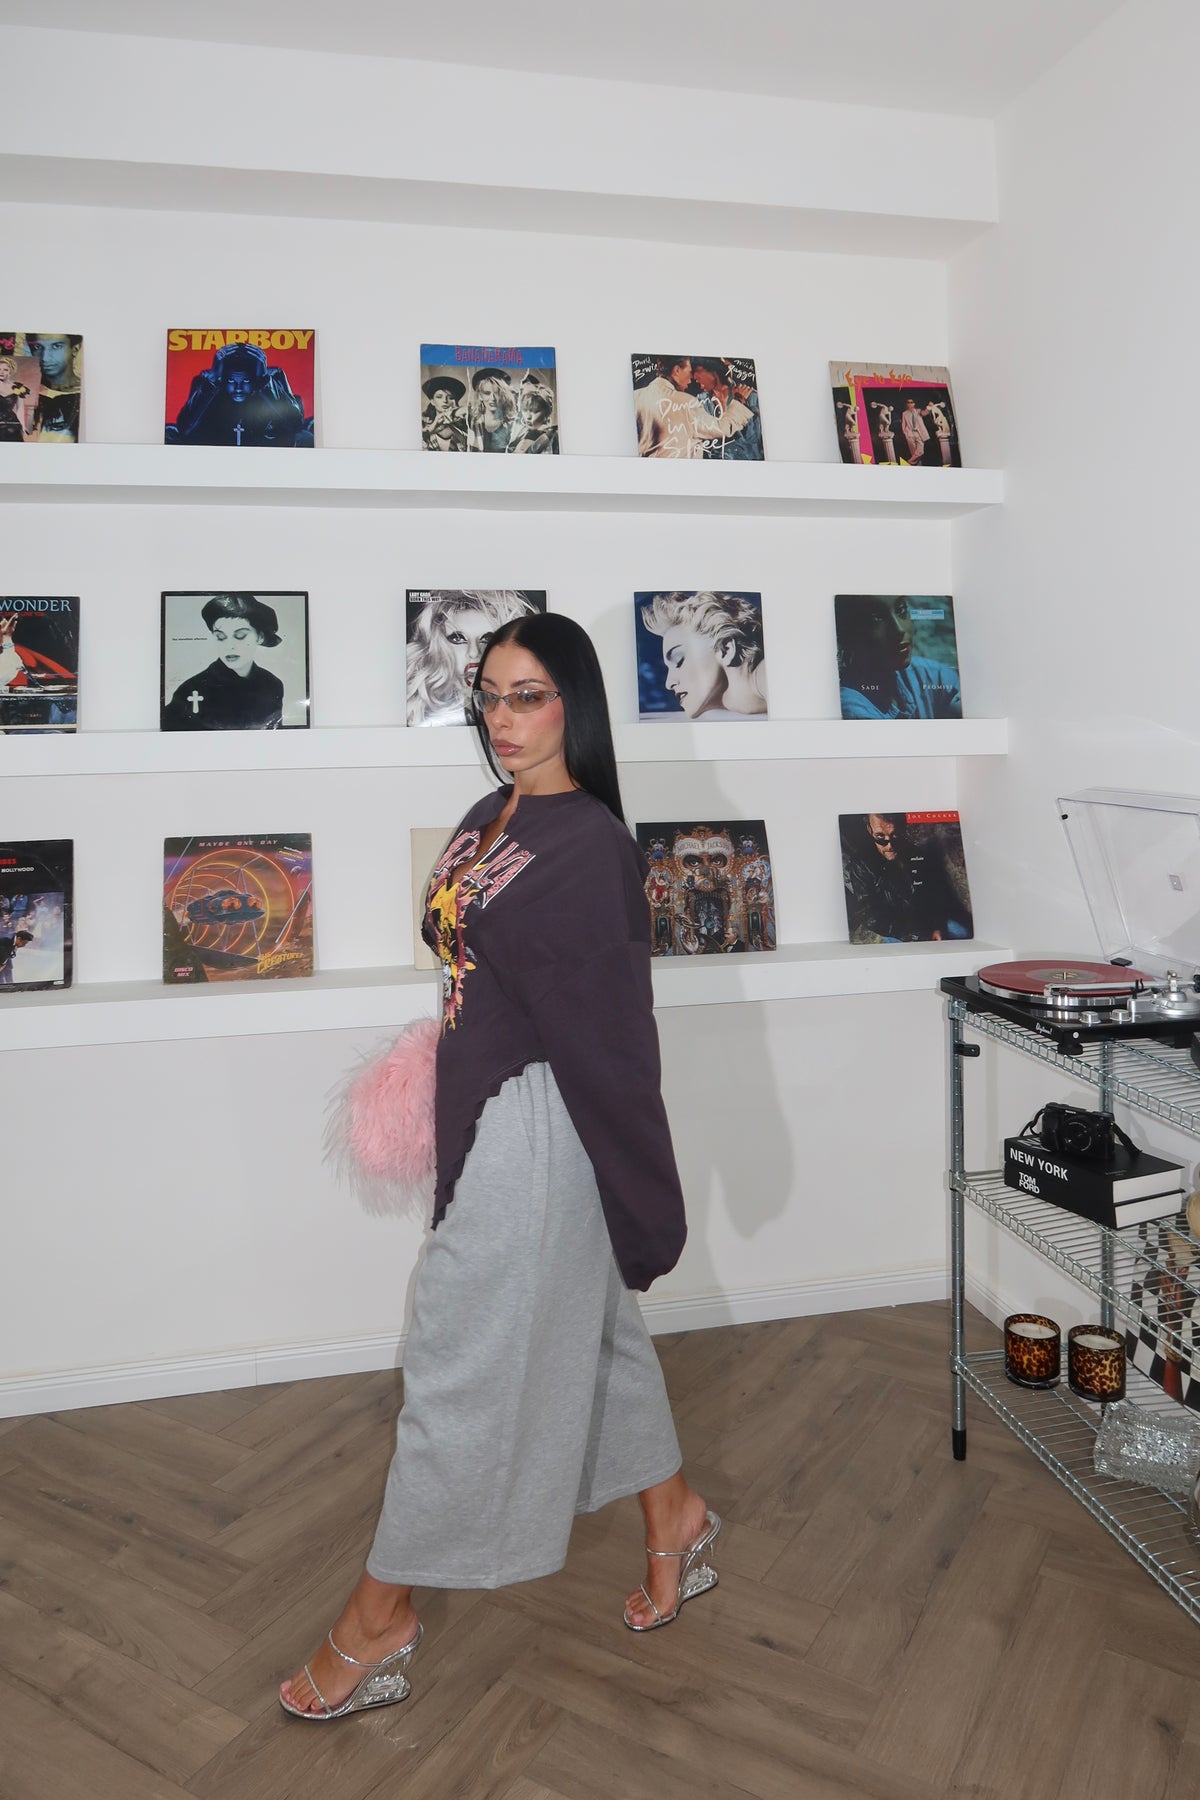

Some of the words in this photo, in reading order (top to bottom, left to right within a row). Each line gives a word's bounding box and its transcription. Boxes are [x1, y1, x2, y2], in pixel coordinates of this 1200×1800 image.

[168, 330, 314, 351] STARBOY
[455, 346, 524, 365] BANANARAMA
[634, 363, 659, 381] Bowie
[657, 395, 724, 420] Dancing
[667, 418, 688, 435] in
[0, 599, 72, 612] WONDER
[1010, 1147, 1035, 1167] NEW
[1037, 1158, 1069, 1182] YORK
[1018, 1171, 1037, 1185] TOM
[1018, 1179, 1040, 1195] FORD
